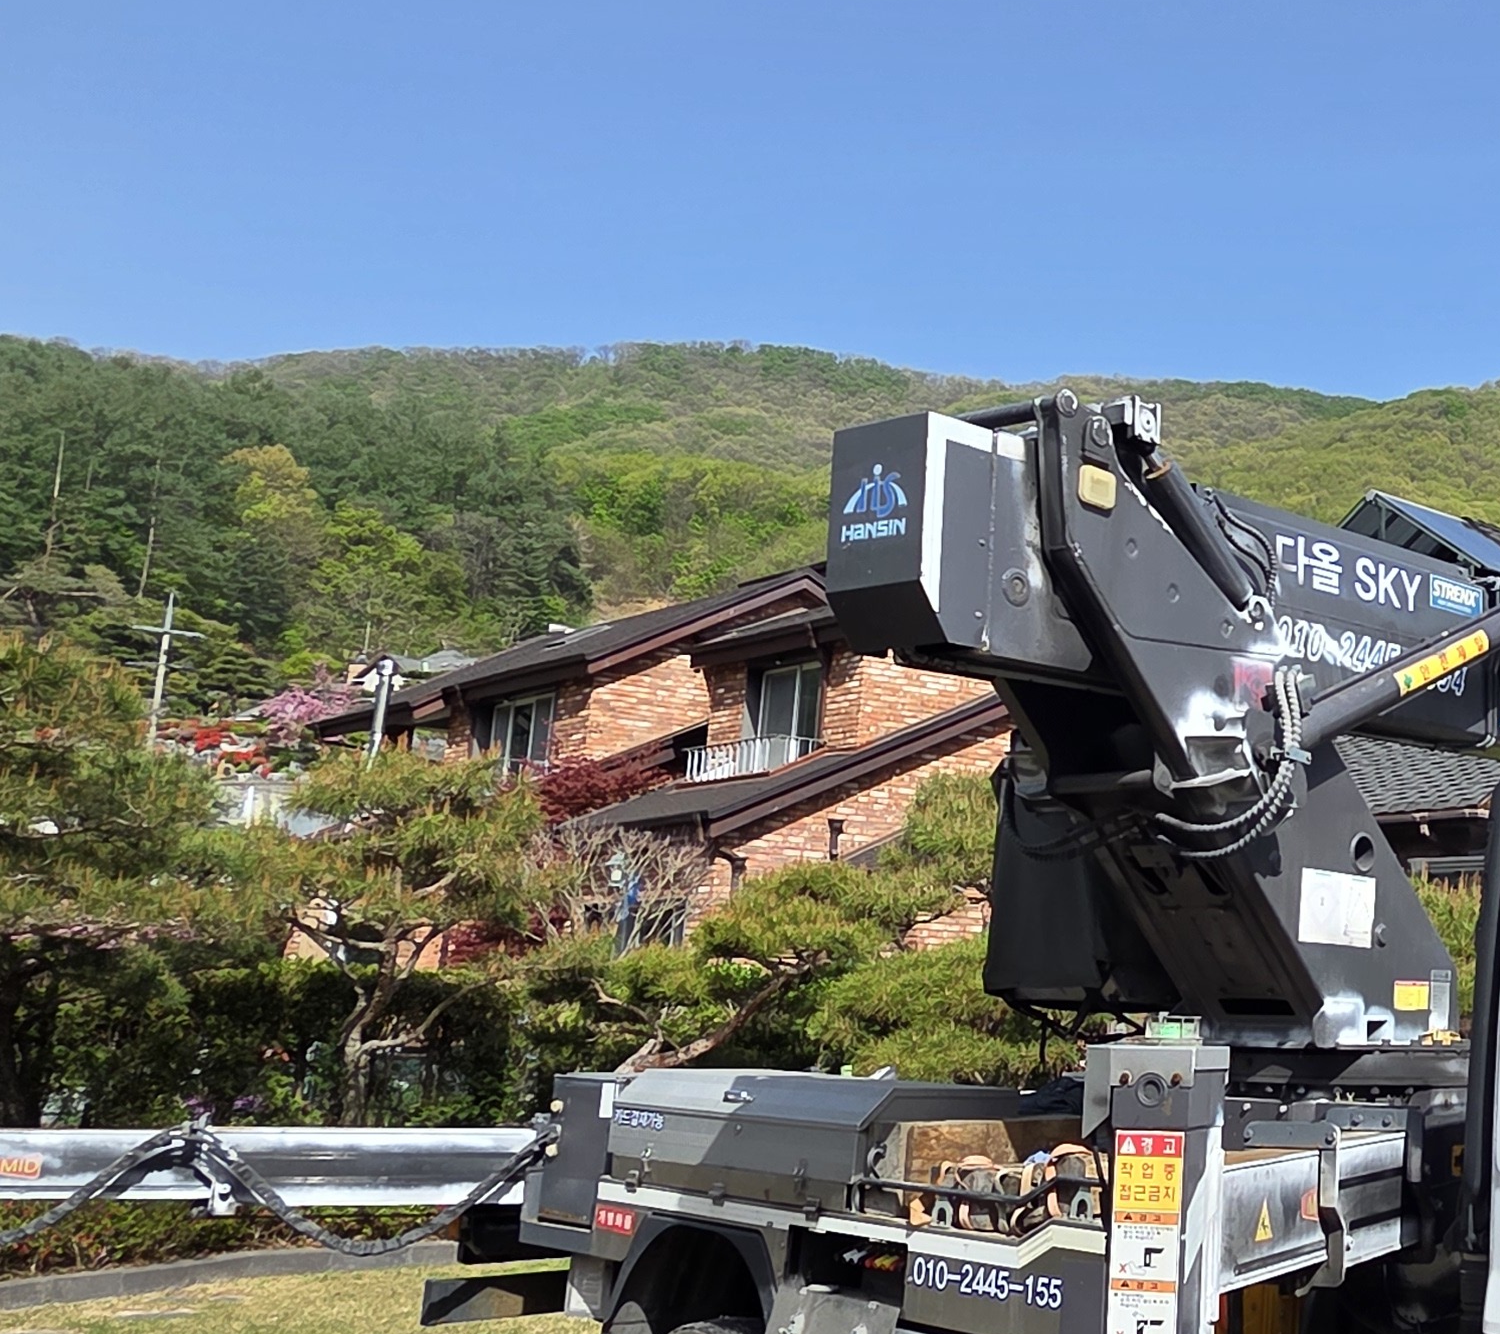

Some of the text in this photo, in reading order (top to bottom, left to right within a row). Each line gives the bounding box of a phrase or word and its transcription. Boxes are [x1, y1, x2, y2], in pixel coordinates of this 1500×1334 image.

[1275, 534, 1422, 612] 다올 SKY
[1432, 578, 1480, 607] STRENX
[1140, 1136, 1176, 1156] 경고
[1119, 1184, 1176, 1203] 접근금지
[913, 1256, 1063, 1309] 010-2445-155
